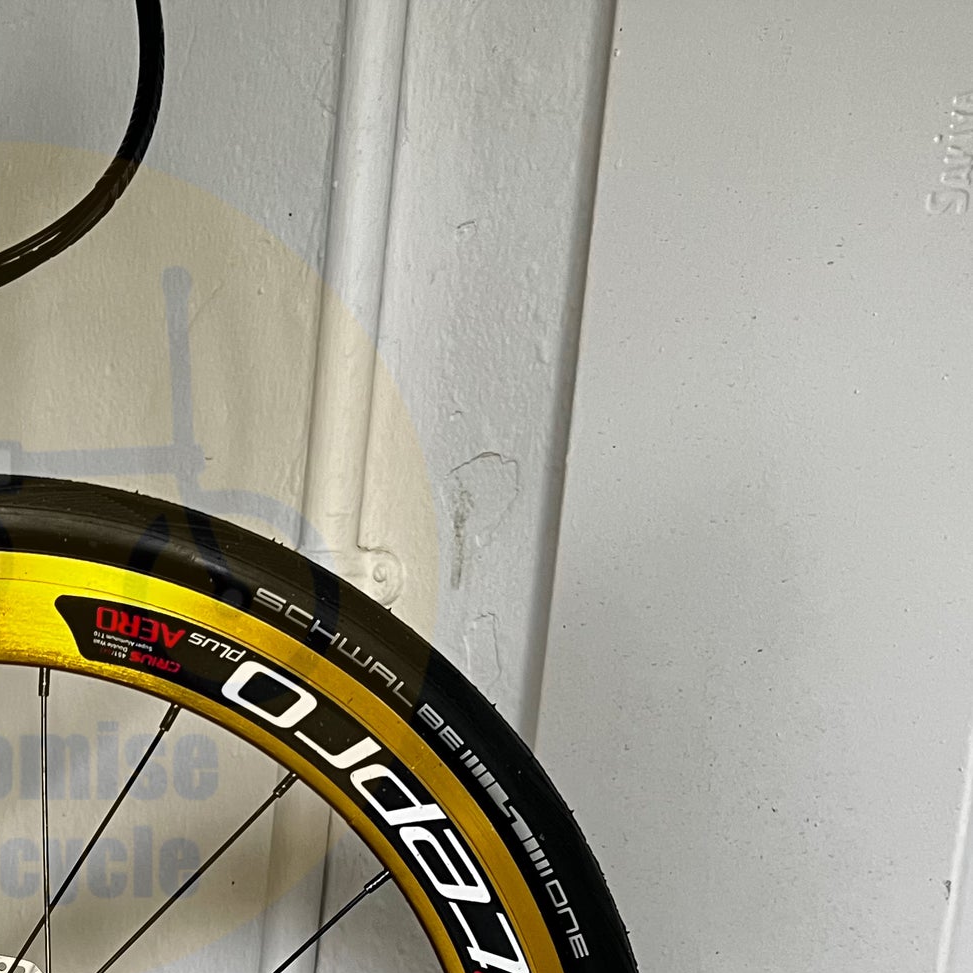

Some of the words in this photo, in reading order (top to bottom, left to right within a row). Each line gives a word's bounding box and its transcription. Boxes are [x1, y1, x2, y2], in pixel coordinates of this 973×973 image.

[95, 606, 186, 649] AERO
[129, 651, 181, 673] CRIUS
[253, 587, 465, 751] SCHWALBE
[545, 878, 590, 959] ONE
